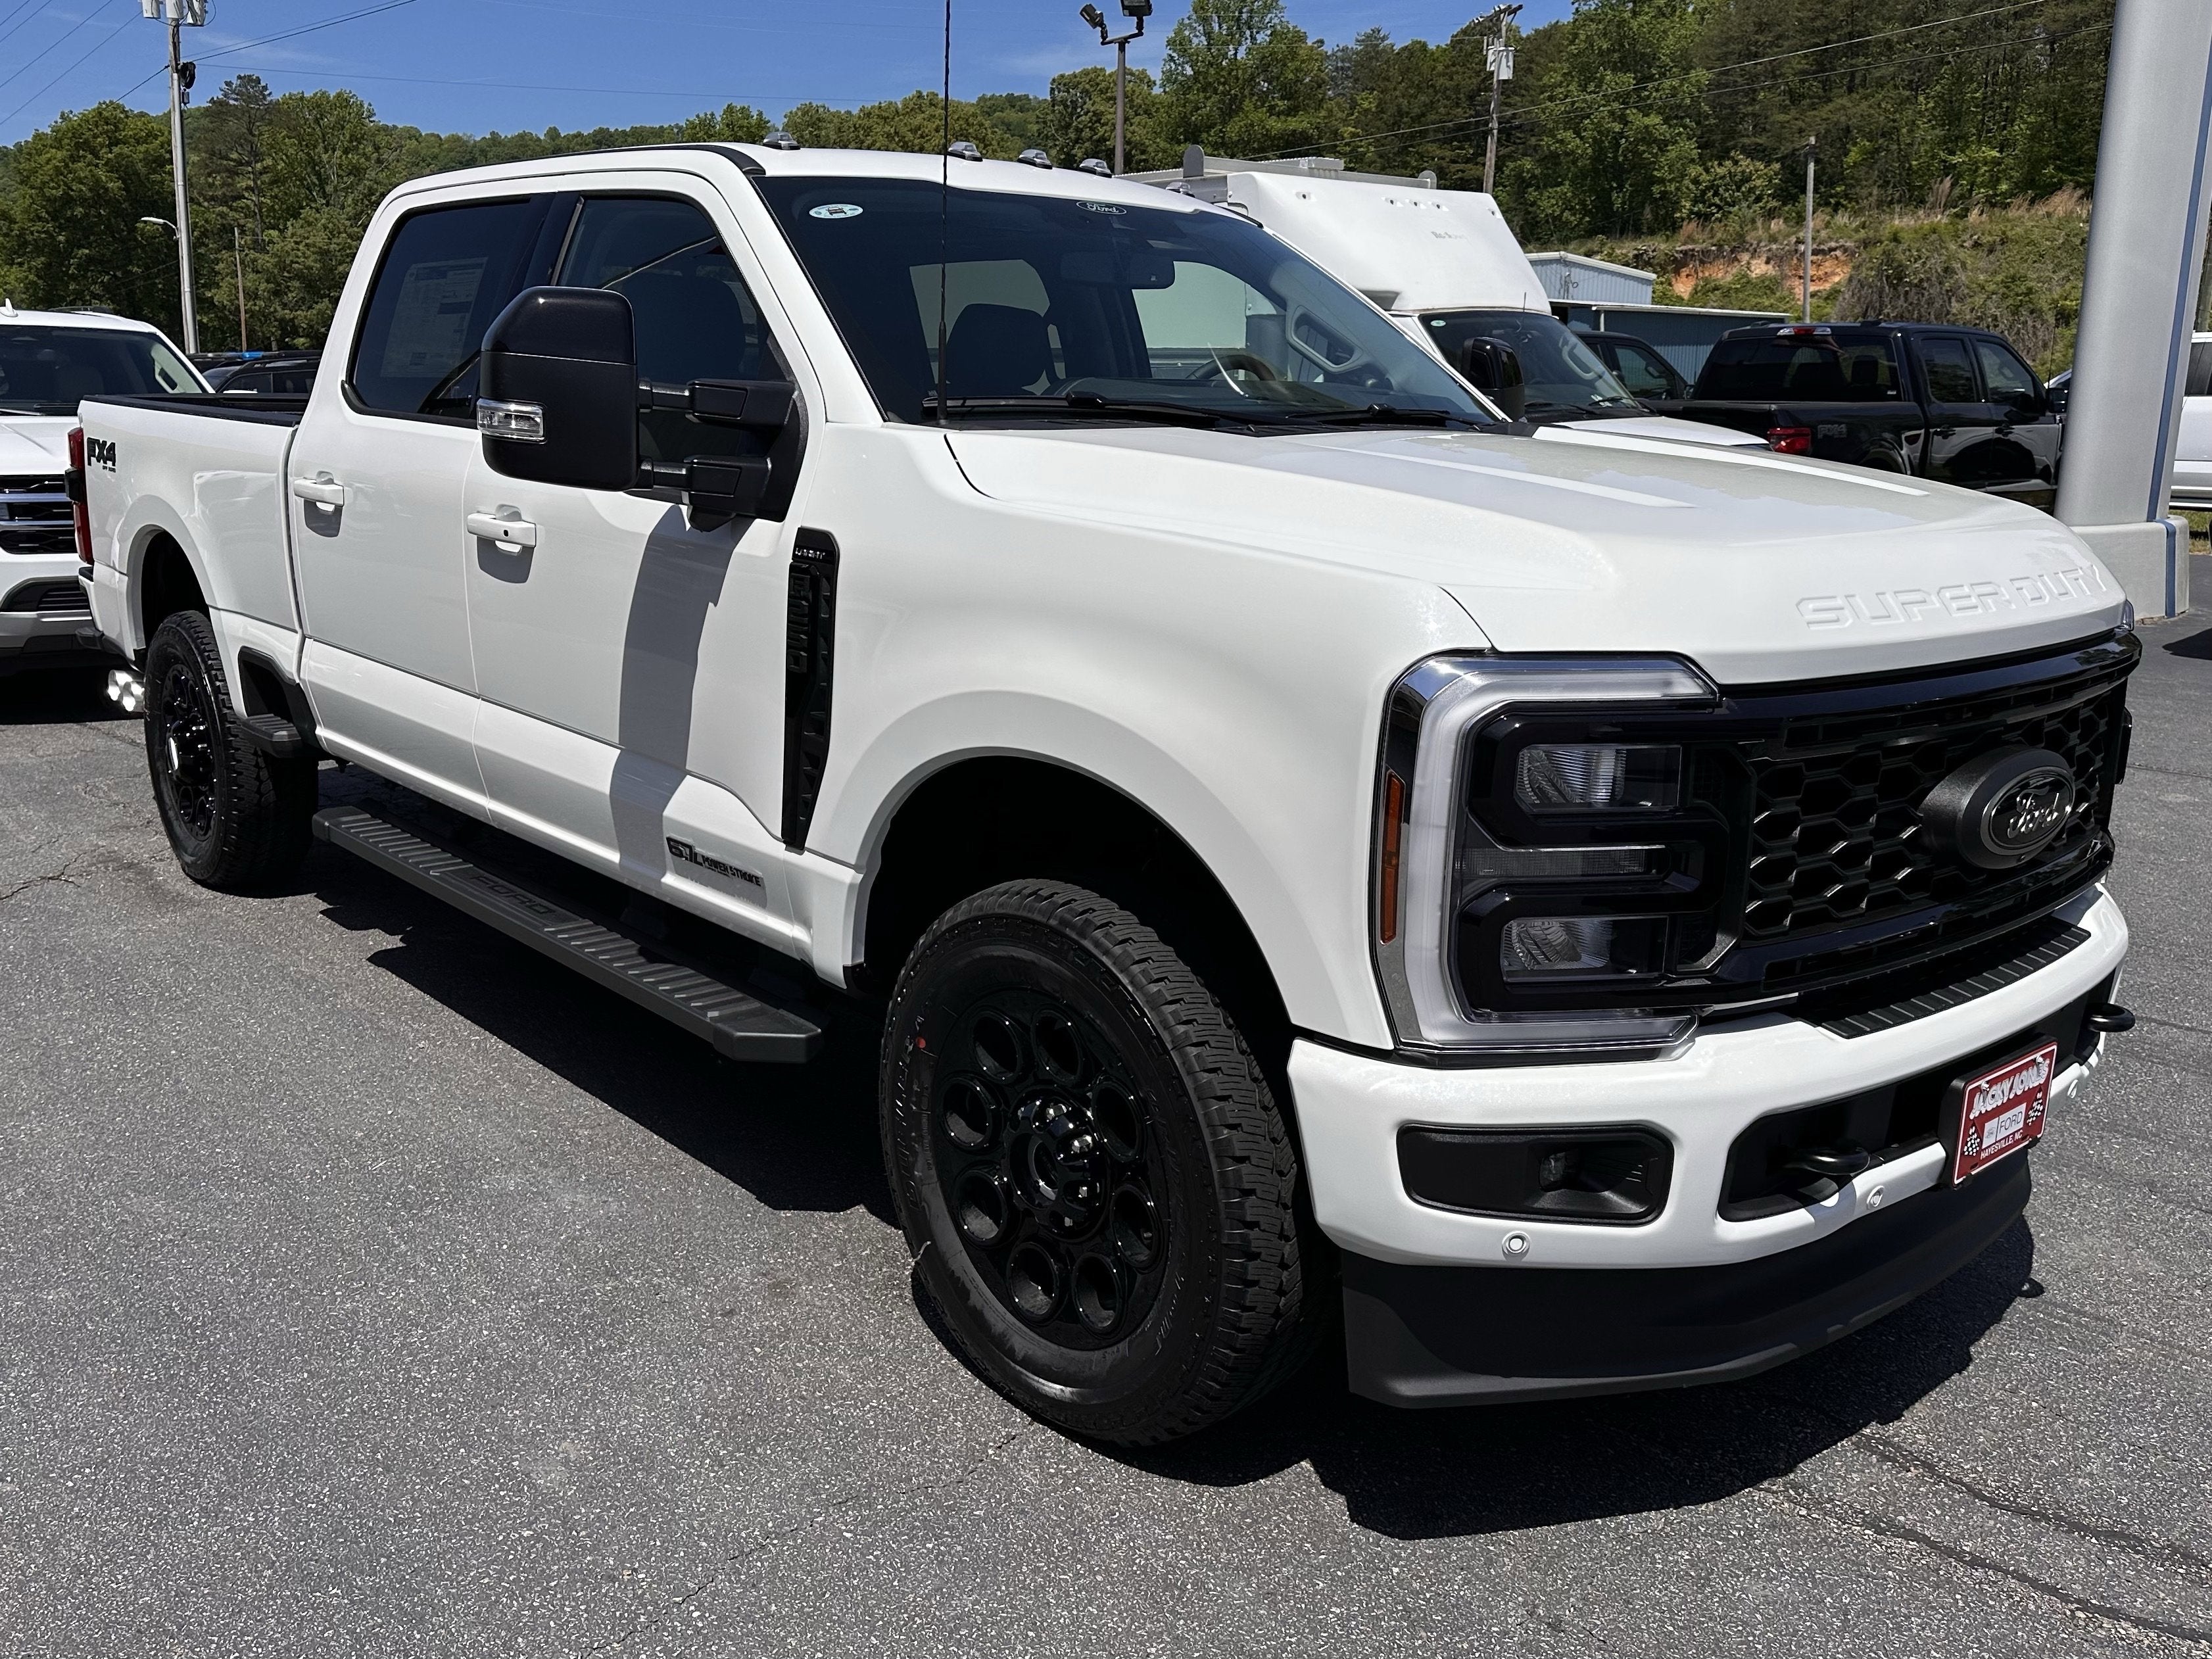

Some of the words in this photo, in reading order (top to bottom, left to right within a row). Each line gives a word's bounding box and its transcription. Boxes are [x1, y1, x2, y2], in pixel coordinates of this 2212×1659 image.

[1086, 202, 1119, 213] Ford
[1817, 424, 1847, 439] FX4
[86, 437, 116, 467] FX4
[1795, 581, 2016, 631] SUPER
[2009, 564, 2107, 607] DUTY
[2007, 786, 2060, 839] Ford
[701, 855, 731, 875] POWER
[729, 865, 762, 887] STROKE
[469, 876, 556, 915] FORD
[1969, 1076, 2015, 1120] JACKY
[2009, 1058, 2050, 1099] JONES
[1998, 1111, 2023, 1134] FORD
[2014, 1129, 2023, 1142] NC
